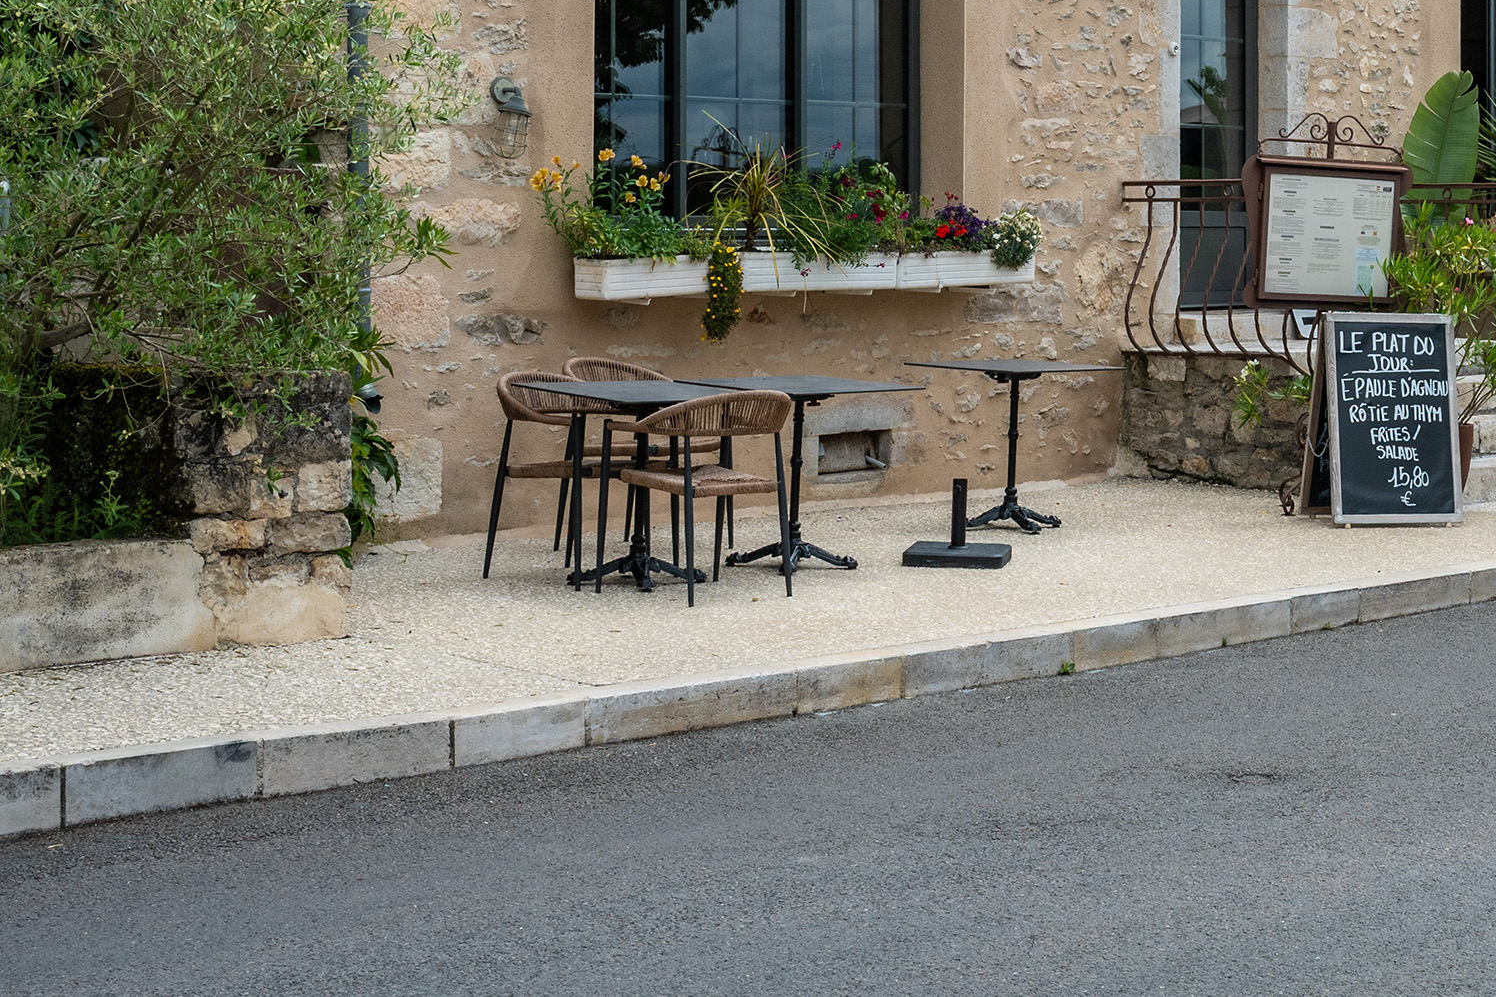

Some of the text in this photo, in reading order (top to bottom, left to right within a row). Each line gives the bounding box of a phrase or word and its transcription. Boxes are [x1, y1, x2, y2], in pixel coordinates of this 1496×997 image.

[1339, 331, 1435, 356] LE PLAT DU
[1367, 353, 1414, 373] JOUR:
[1340, 373, 1449, 401] ÉPAULE D'AGNEAU
[1393, 405, 1409, 422] AU
[1408, 405, 1443, 423] THYM
[1370, 426, 1411, 445] FRITES
[1376, 445, 1420, 462] SALADE
[1387, 465, 1430, 489] 15,80
[1400, 490, 1416, 507] €
